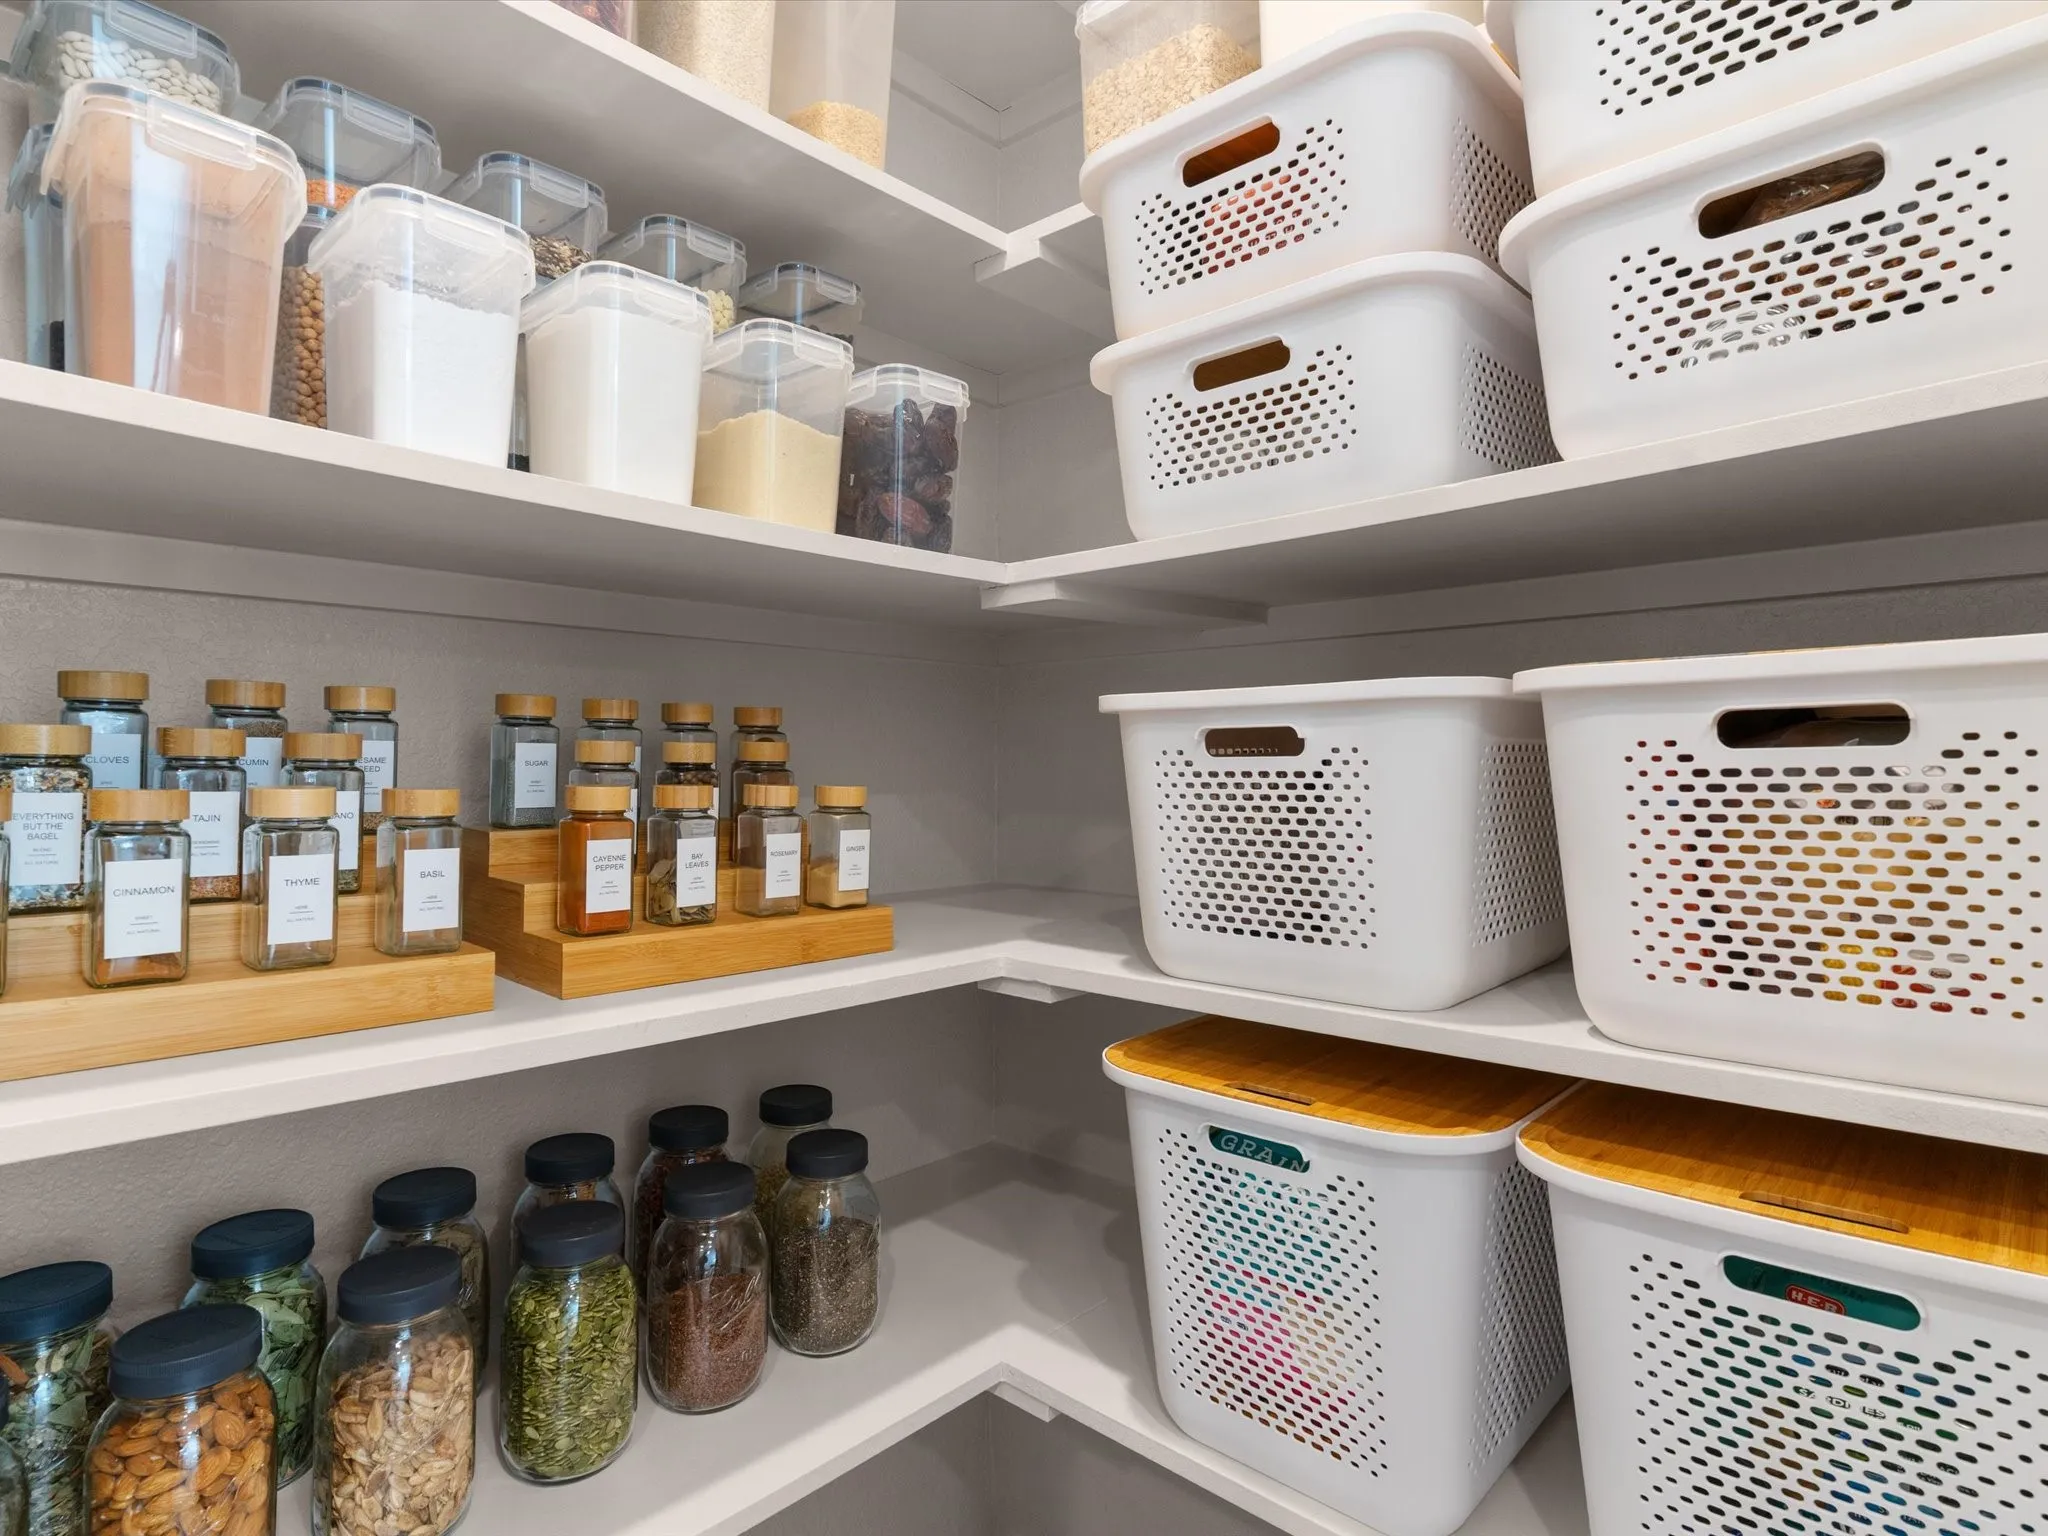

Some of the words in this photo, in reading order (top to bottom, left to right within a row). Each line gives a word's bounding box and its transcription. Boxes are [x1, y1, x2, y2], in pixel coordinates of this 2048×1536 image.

[85, 756, 130, 764] CLOVES
[359, 765, 381, 773] EED
[13, 812, 75, 821] EVERYTHING
[193, 814, 221, 822] TAJIN
[23, 823, 42, 831] BUT
[45, 822, 63, 830] THE
[27, 832, 59, 841] BAGEL
[592, 854, 627, 863] CAYENNE
[691, 853, 704, 861] BAY
[595, 863, 624, 872] PEPPER
[685, 860, 709, 869] LEAVES
[420, 870, 446, 879] BASIL
[284, 877, 320, 887] THYME
[112, 886, 175, 897] CINNAMON
